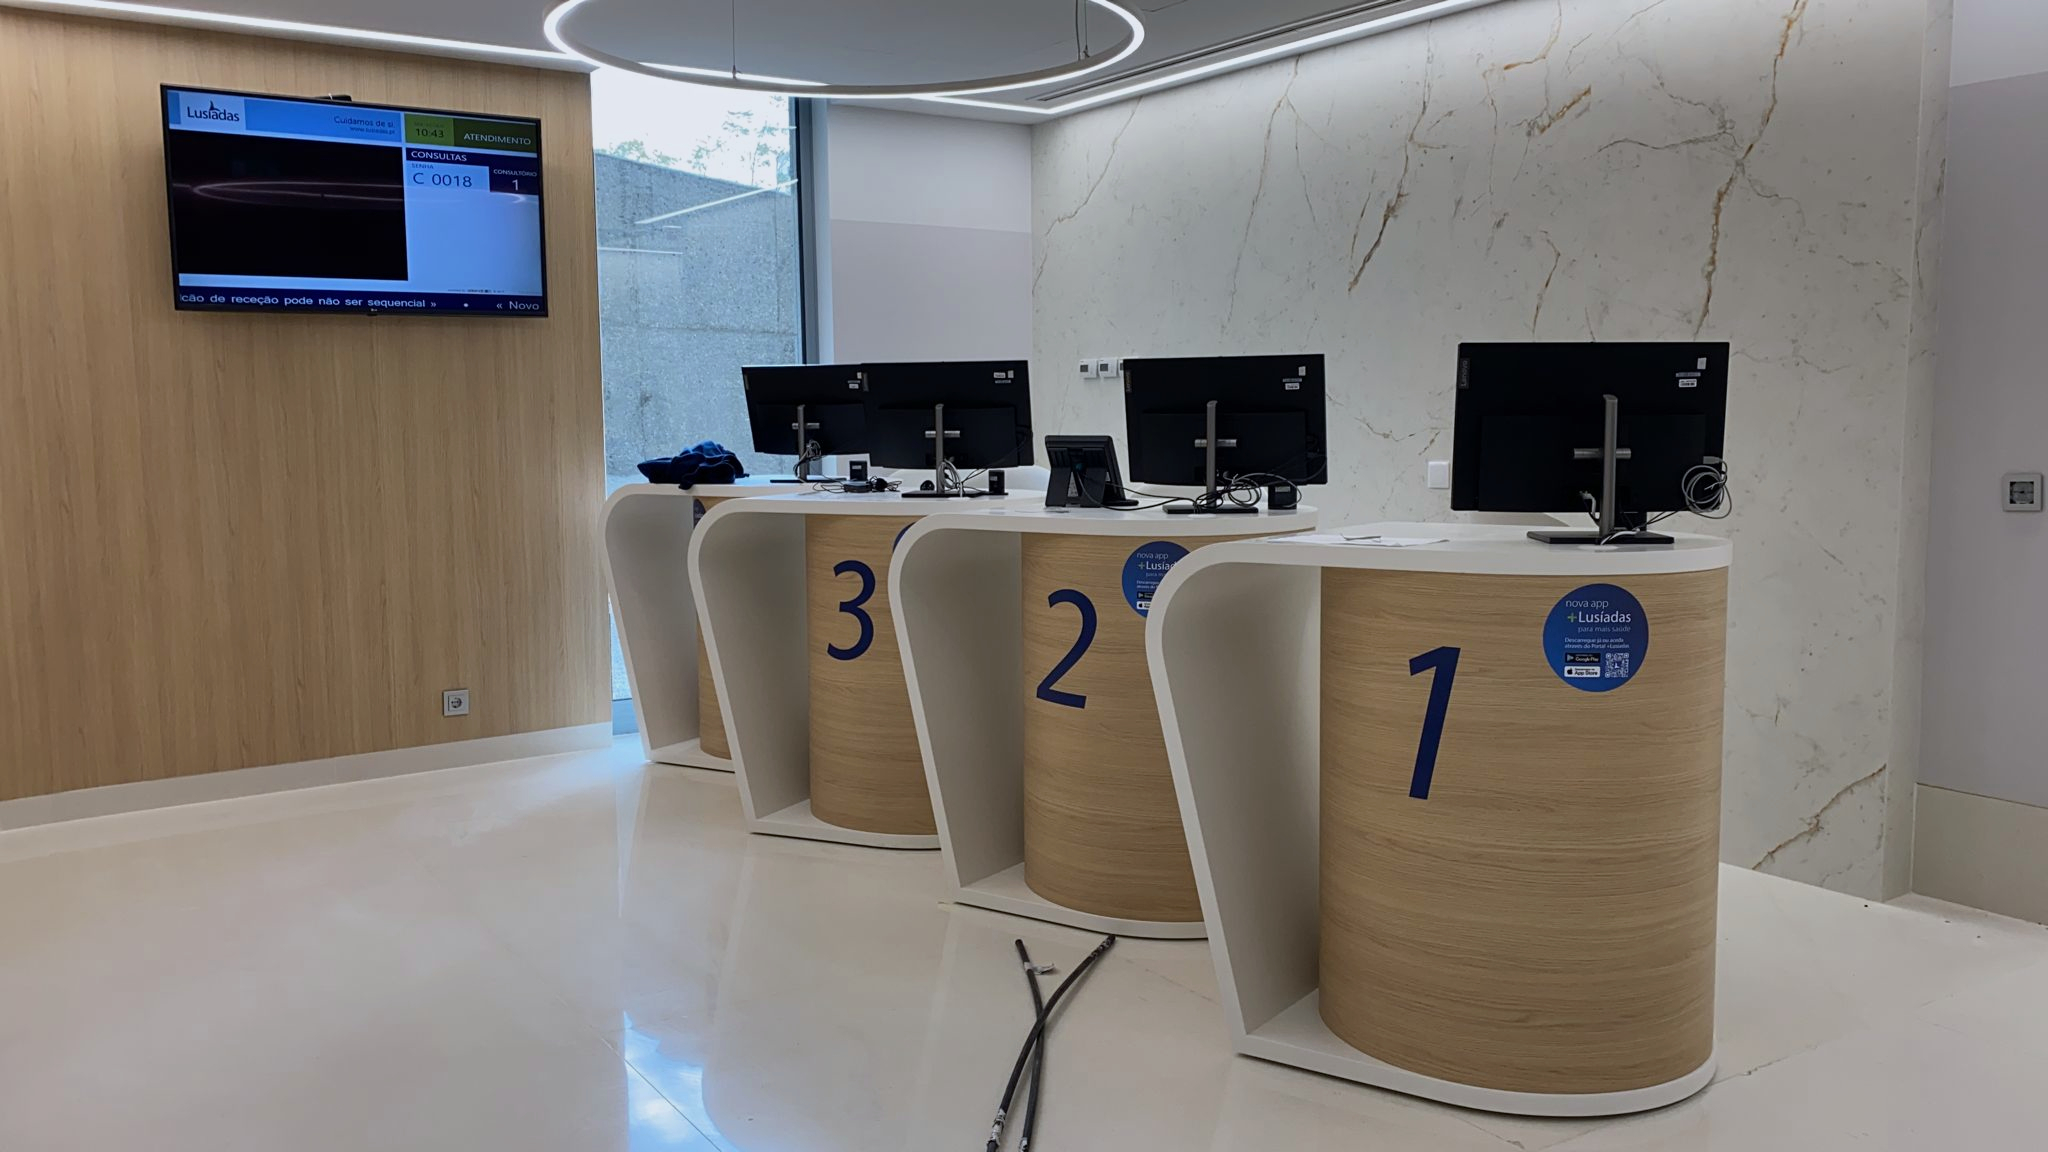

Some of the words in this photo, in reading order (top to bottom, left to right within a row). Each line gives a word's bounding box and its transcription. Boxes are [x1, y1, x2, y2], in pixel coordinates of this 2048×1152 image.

[334, 116, 373, 126] Cuidamos
[375, 120, 386, 128] de
[415, 128, 445, 138] 10:43
[463, 133, 532, 145] ATENDIMENTO
[411, 150, 468, 162] CONSULTAS
[413, 172, 425, 185] C
[431, 173, 473, 187] 0018
[512, 179, 520, 191] 1
[210, 294, 226, 303] de
[231, 294, 279, 306] receção
[284, 296, 313, 307] pode
[318, 296, 340, 306] não
[345, 298, 363, 307] ser
[367, 298, 426, 310] sequencial
[509, 301, 540, 312] Novo
[827, 559, 876, 661] 3
[1591, 601, 1609, 609] app
[1611, 625, 1632, 633] saúde
[1036, 588, 1098, 709] 2
[1409, 646, 1461, 800] 1
